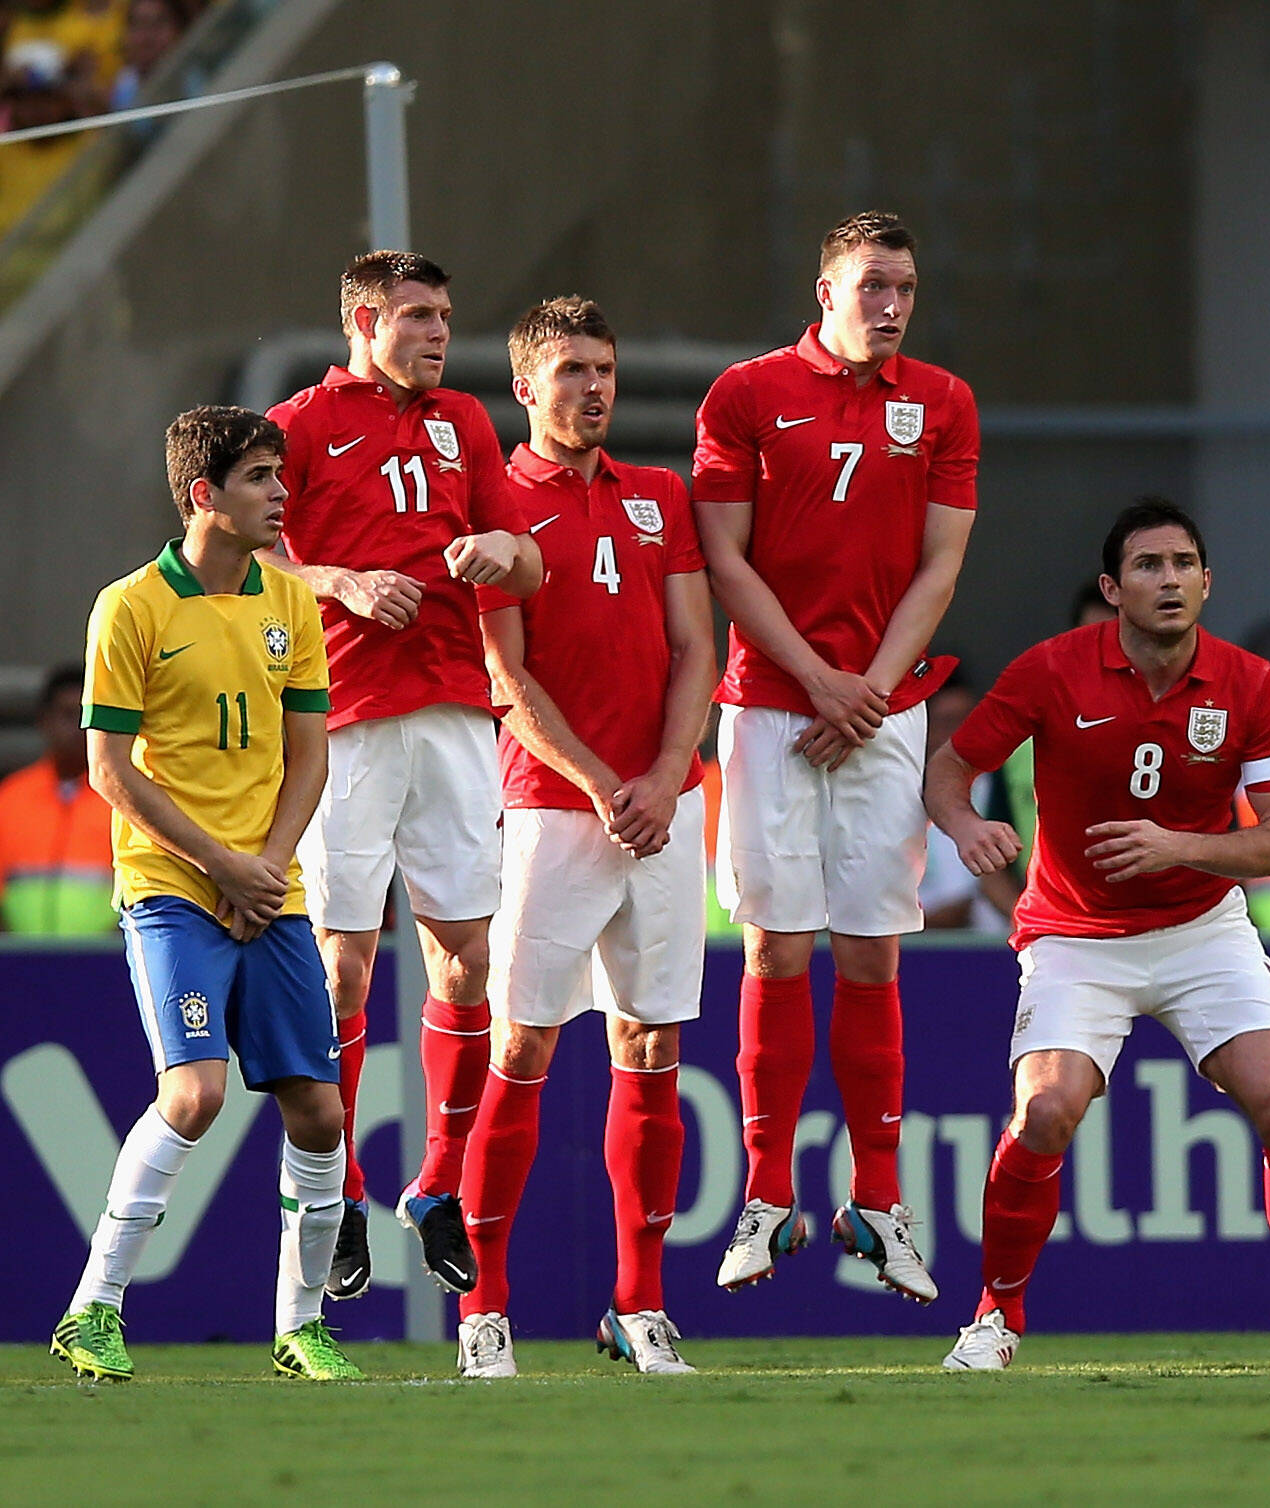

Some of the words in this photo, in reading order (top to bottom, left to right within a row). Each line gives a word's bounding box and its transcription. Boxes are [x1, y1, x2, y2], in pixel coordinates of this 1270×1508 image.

[380, 455, 428, 513] 11
[830, 442, 863, 502] 7
[593, 536, 620, 594] 4
[216, 692, 248, 750] 11
[1130, 743, 1163, 799] 8
